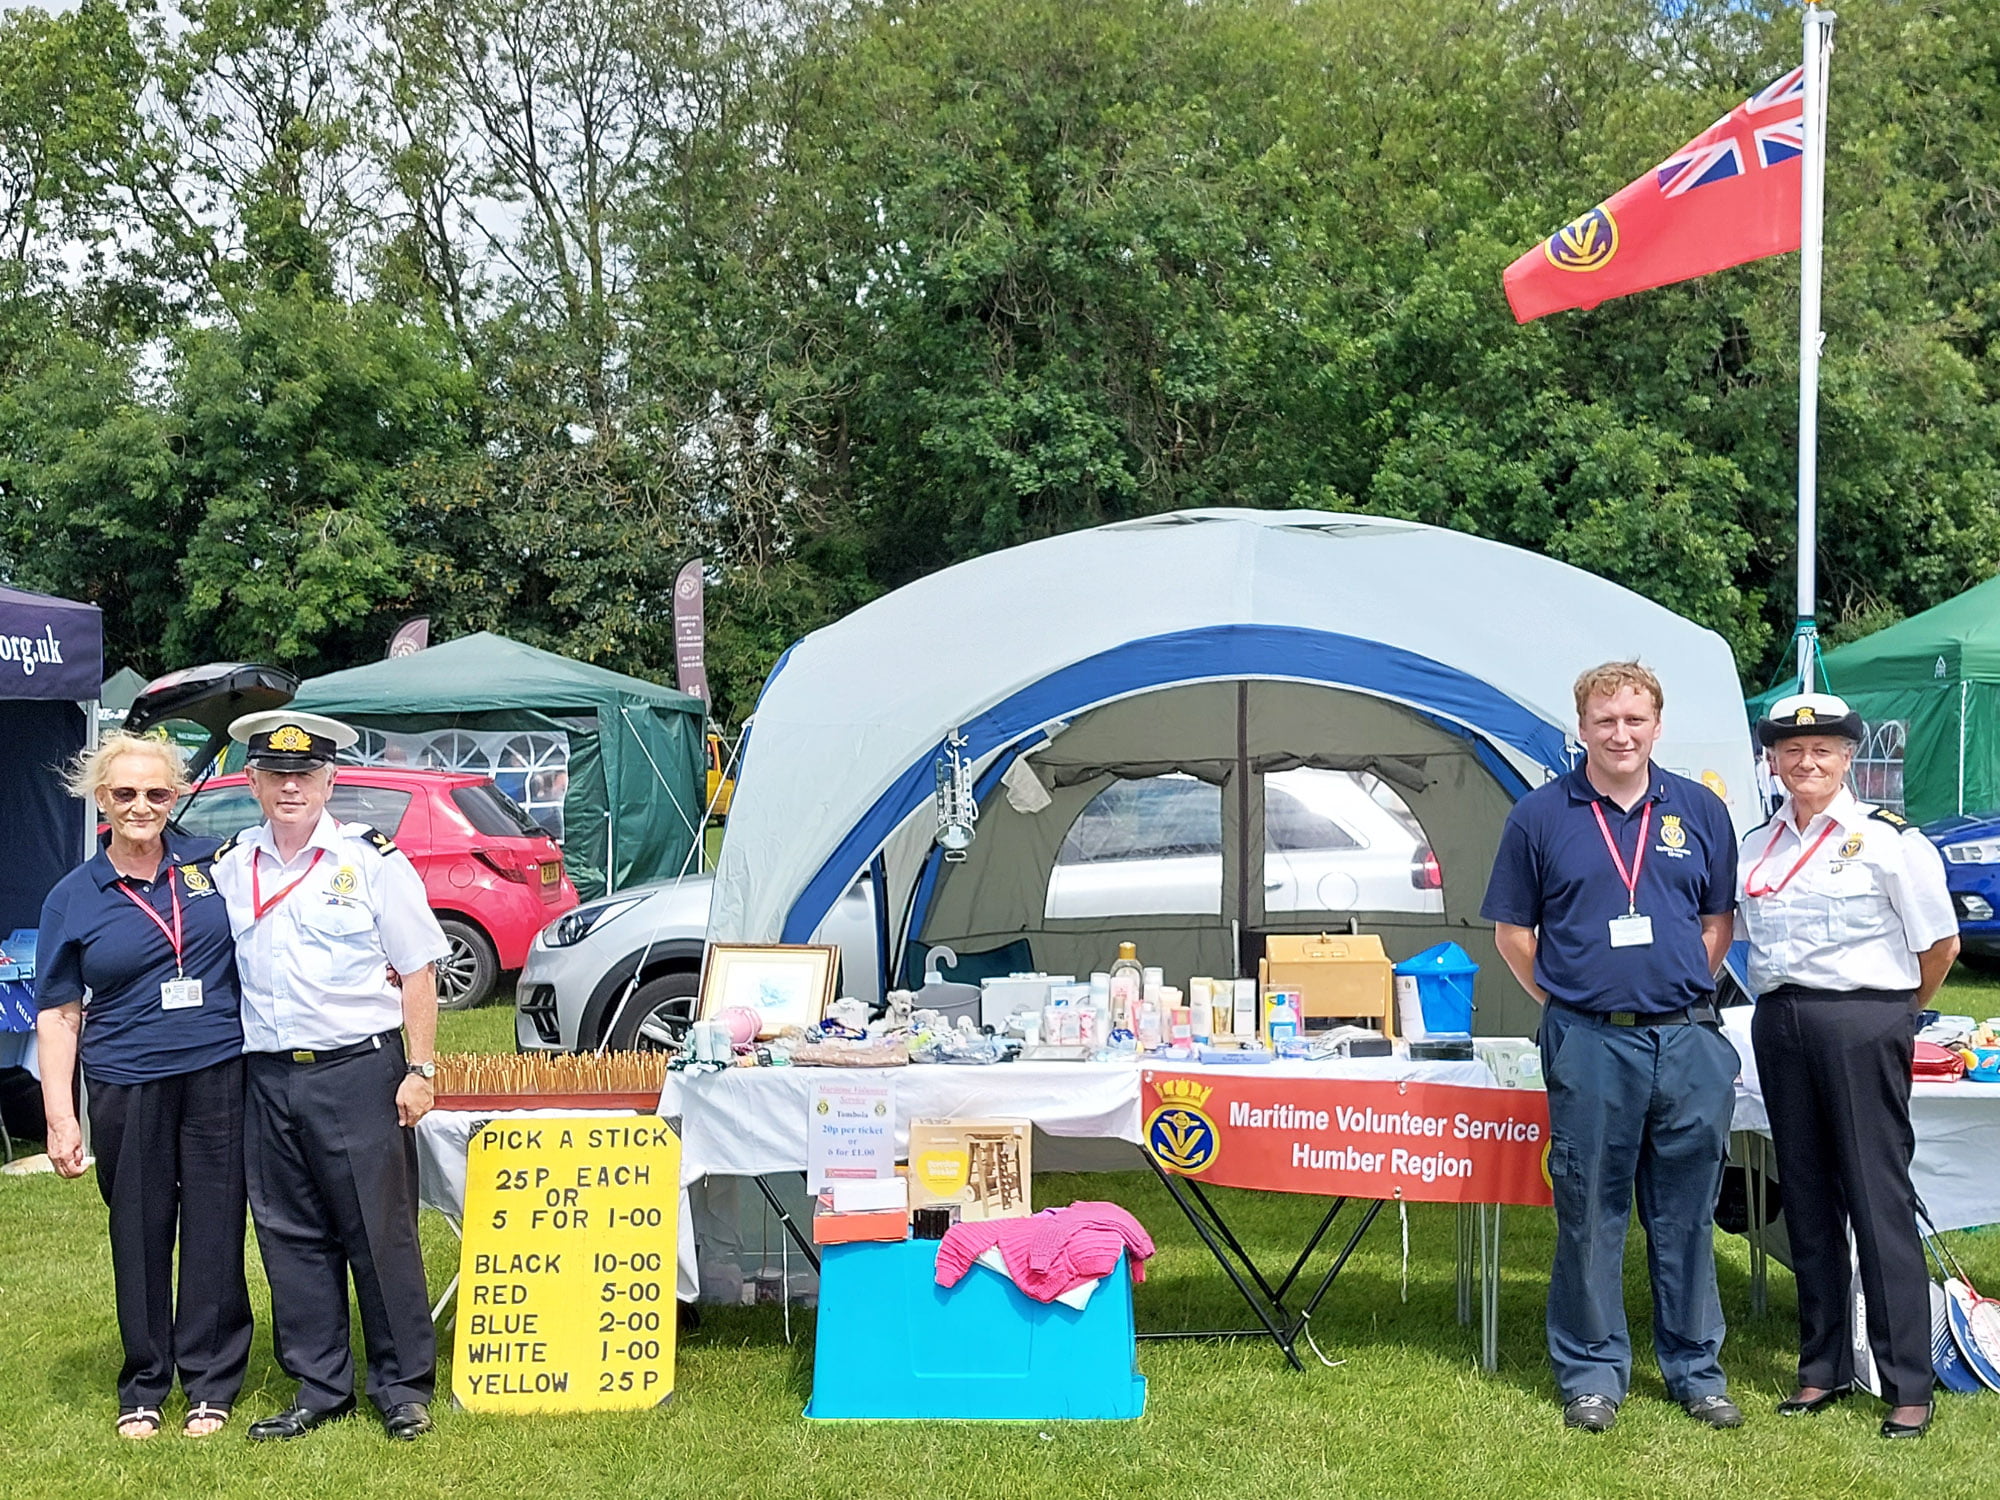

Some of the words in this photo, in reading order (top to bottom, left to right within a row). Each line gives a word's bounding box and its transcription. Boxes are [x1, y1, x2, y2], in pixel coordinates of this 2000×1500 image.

[822, 1124, 839, 1135] 20p
[841, 1126, 856, 1135] per
[858, 1125, 884, 1135] ticket
[1229, 1101, 1330, 1131] Maritime
[1335, 1105, 1448, 1138] Volunteer
[1453, 1112, 1540, 1143] Service
[483, 1130, 543, 1150] PICK
[559, 1130, 574, 1149] A
[588, 1127, 668, 1148] STICK
[836, 1148, 848, 1156] for
[851, 1148, 876, 1156] £1.00
[1292, 1142, 1386, 1174] Humber
[1391, 1148, 1473, 1183] Region
[577, 1165, 650, 1188] EACH
[546, 1188, 579, 1207] OR
[491, 1210, 508, 1229] 5
[532, 1210, 589, 1229] FOR
[609, 1208, 661, 1228] 1-00
[475, 1253, 561, 1274] BLACK
[594, 1252, 661, 1273] 10-00
[473, 1285, 528, 1305] RED
[600, 1282, 660, 1302] 5-00
[470, 1314, 538, 1335] BLUE
[599, 1311, 660, 1333] 2-00
[468, 1342, 547, 1363] WHITE
[601, 1340, 660, 1361] 1-00
[468, 1372, 569, 1395] YELLOW
